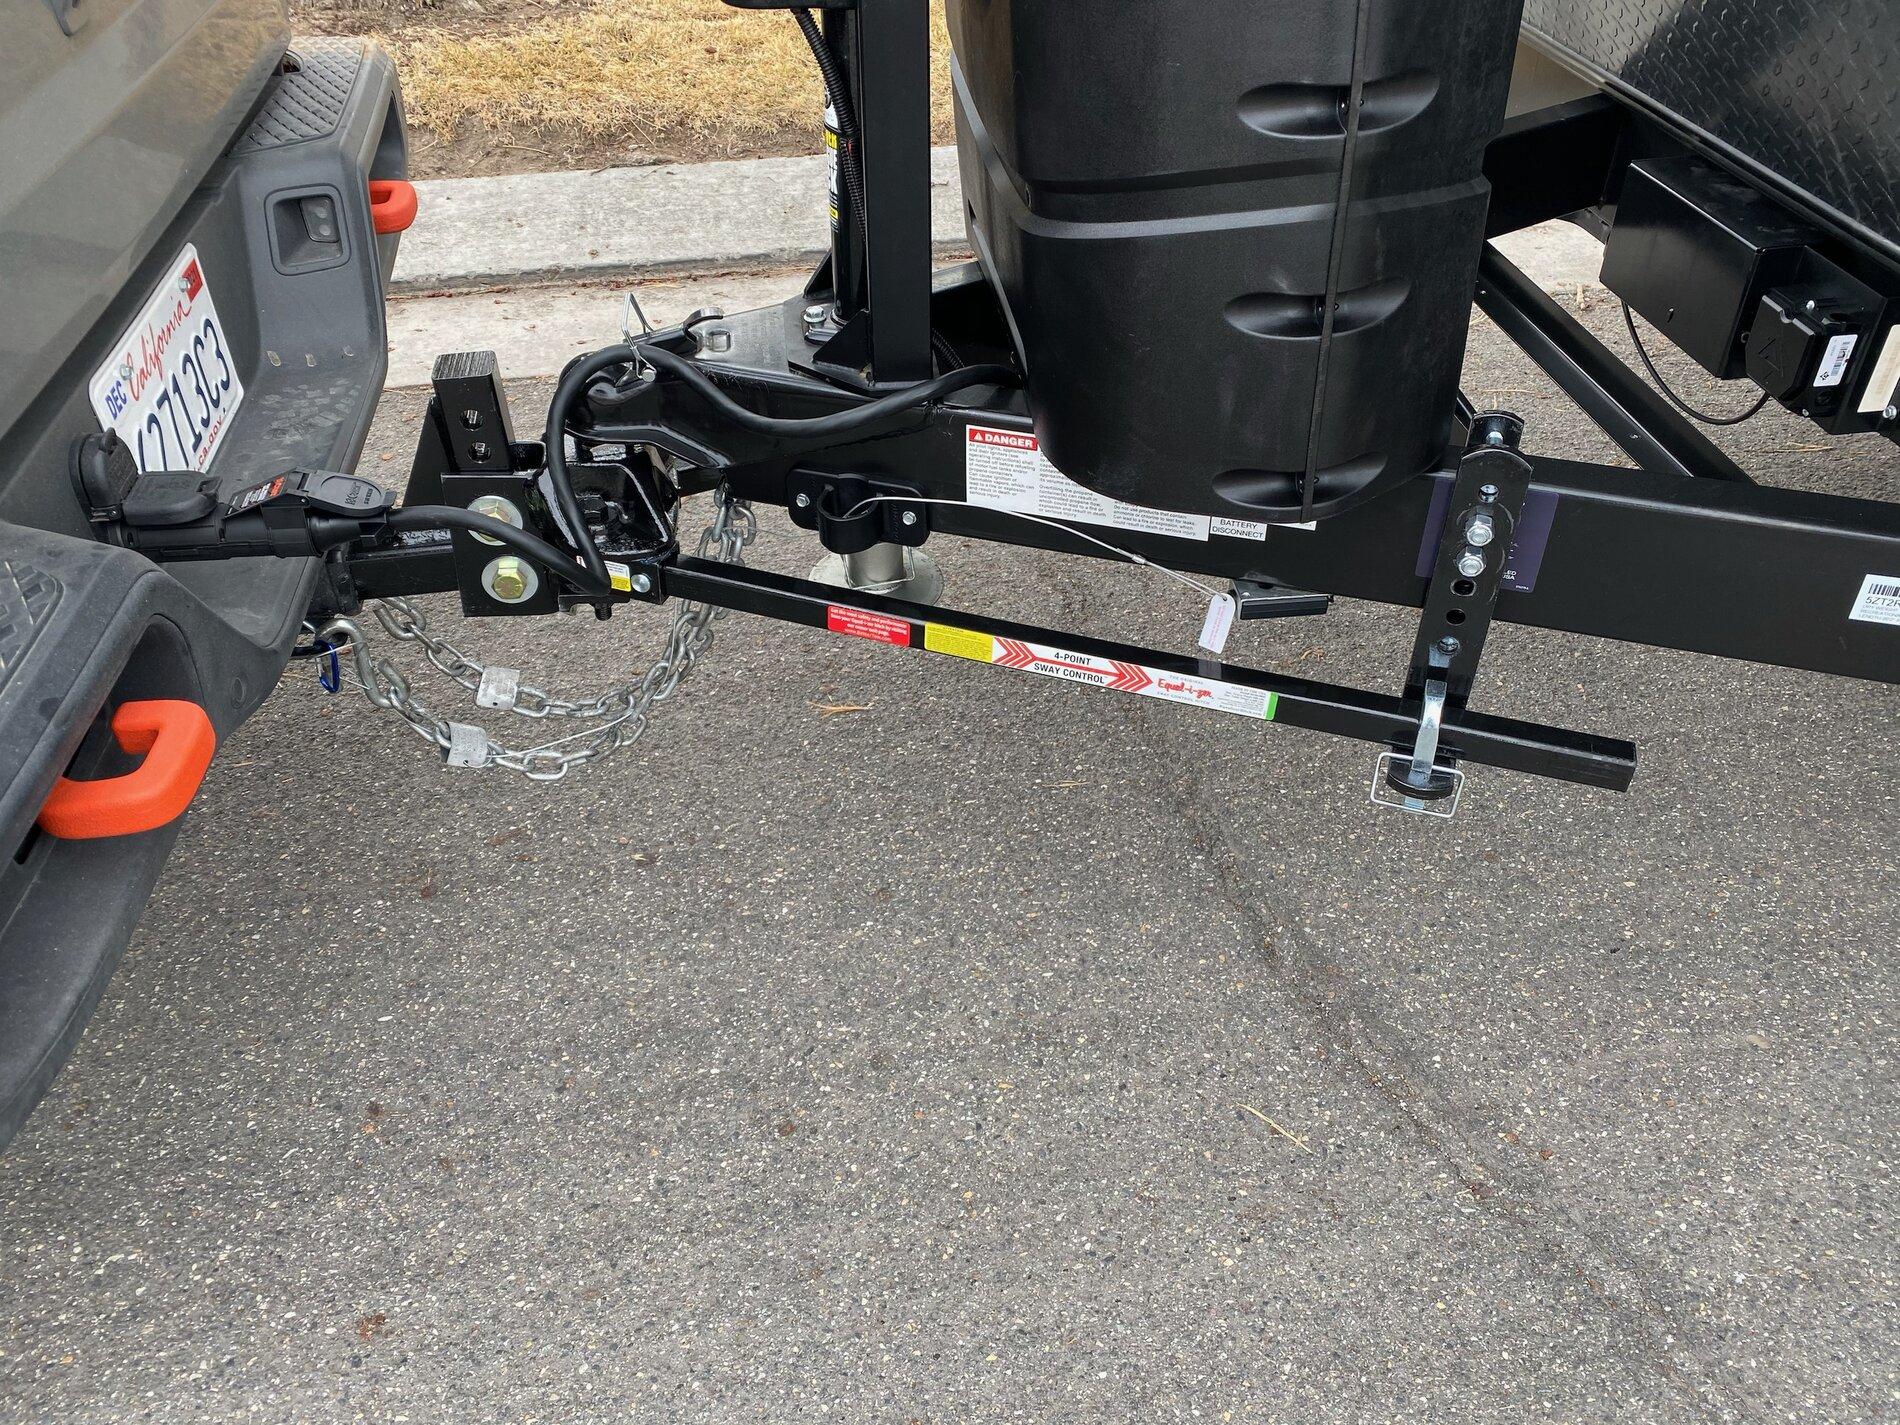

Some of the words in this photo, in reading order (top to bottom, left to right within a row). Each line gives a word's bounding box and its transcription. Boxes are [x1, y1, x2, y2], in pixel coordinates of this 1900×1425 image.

[125, 300, 192, 401] California
[105, 380, 127, 420] DEC
[985, 434, 1033, 448] DANGER
[1212, 526, 1263, 538] DISCONNECT
[1220, 519, 1257, 529] BATTERY
[1054, 652, 1091, 665] 4-POINT
[1034, 664, 1060, 675] SWAY
[1063, 668, 1104, 683] CONTROL
[1158, 678, 1212, 699] Equal-i-zer
